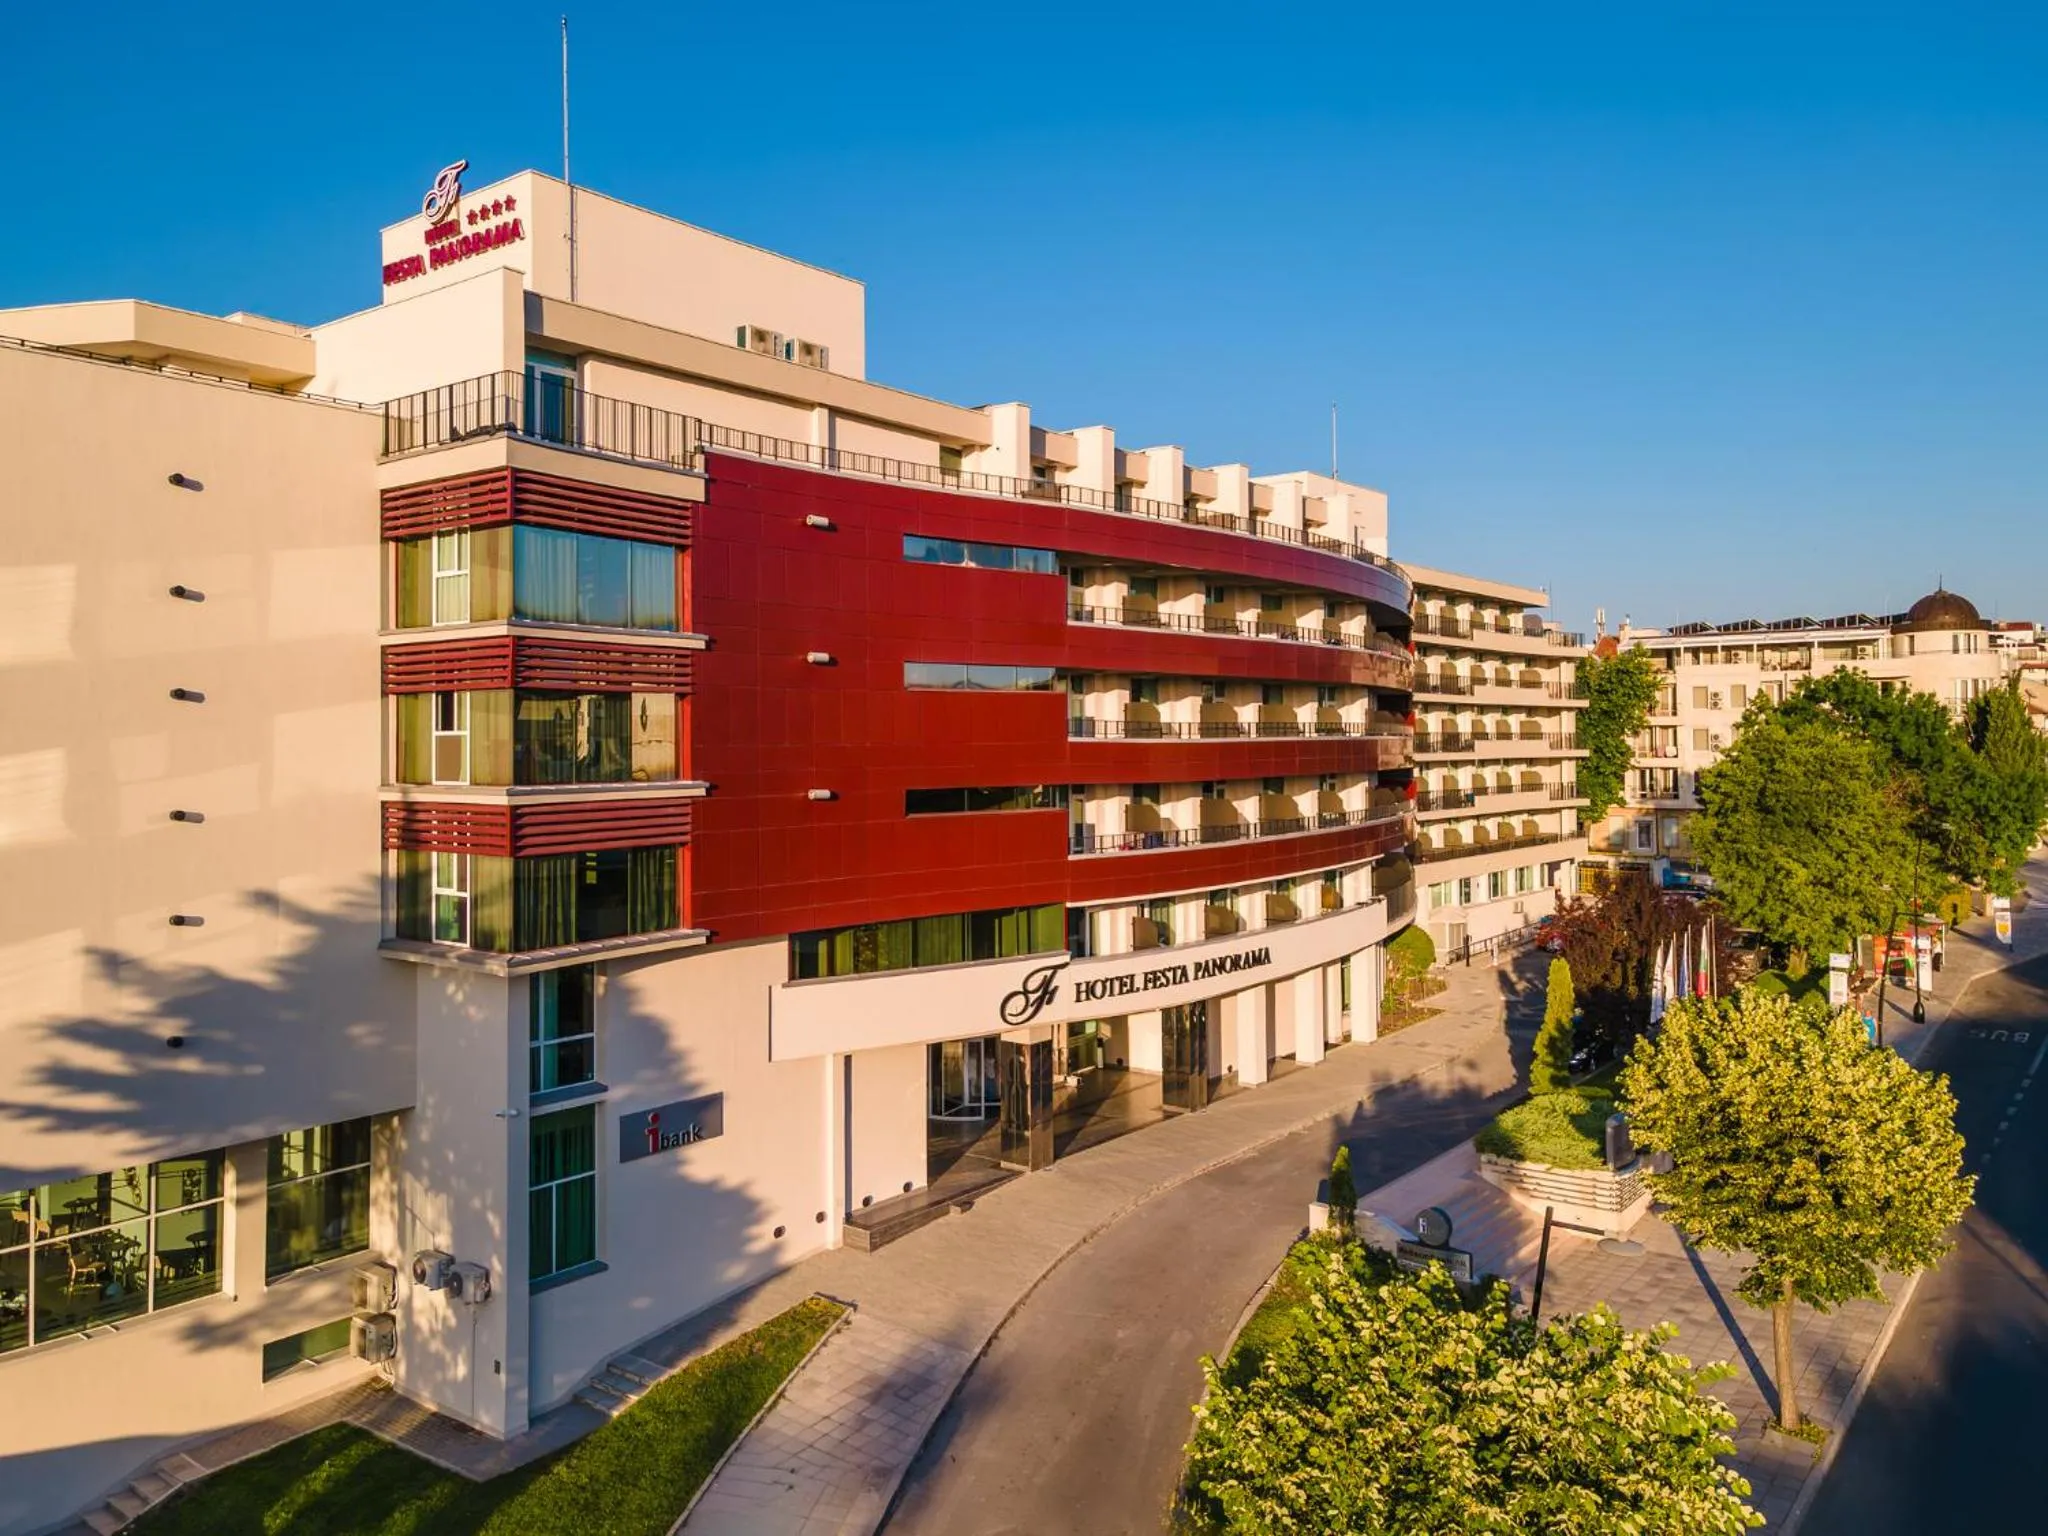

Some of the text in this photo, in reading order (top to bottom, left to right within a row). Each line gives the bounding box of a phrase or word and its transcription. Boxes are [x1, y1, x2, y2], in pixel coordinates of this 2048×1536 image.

[429, 218, 525, 271] PANORAMA
[1074, 946, 1273, 1003] HOTEL FESTA PANORAMA
